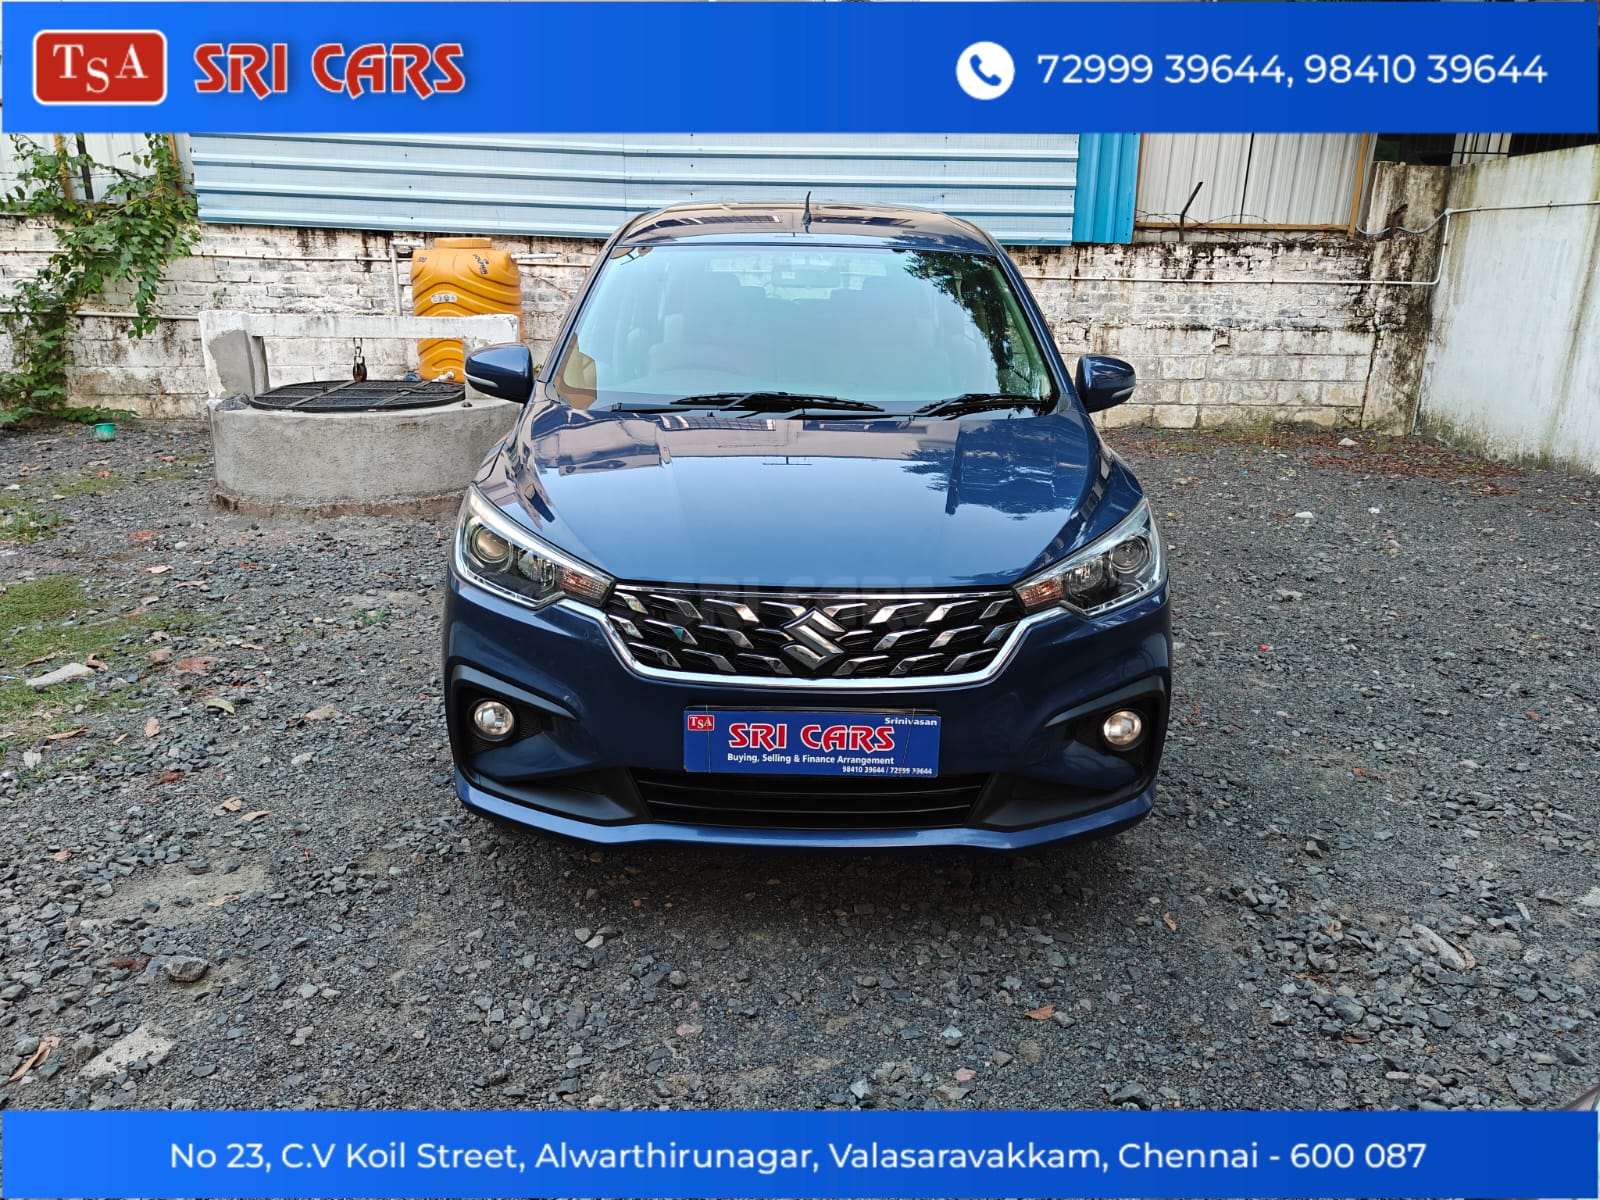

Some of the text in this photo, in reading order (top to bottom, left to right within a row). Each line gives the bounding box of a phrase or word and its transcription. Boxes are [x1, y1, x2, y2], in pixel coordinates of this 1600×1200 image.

[884, 717, 938, 726] Srinivasan
[728, 722, 896, 754] SRI CARS
[727, 753, 895, 766] Buying, Selling & Finance Arrangement
[842, 765, 863, 773] 98410
[864, 766, 885, 774] 39644
